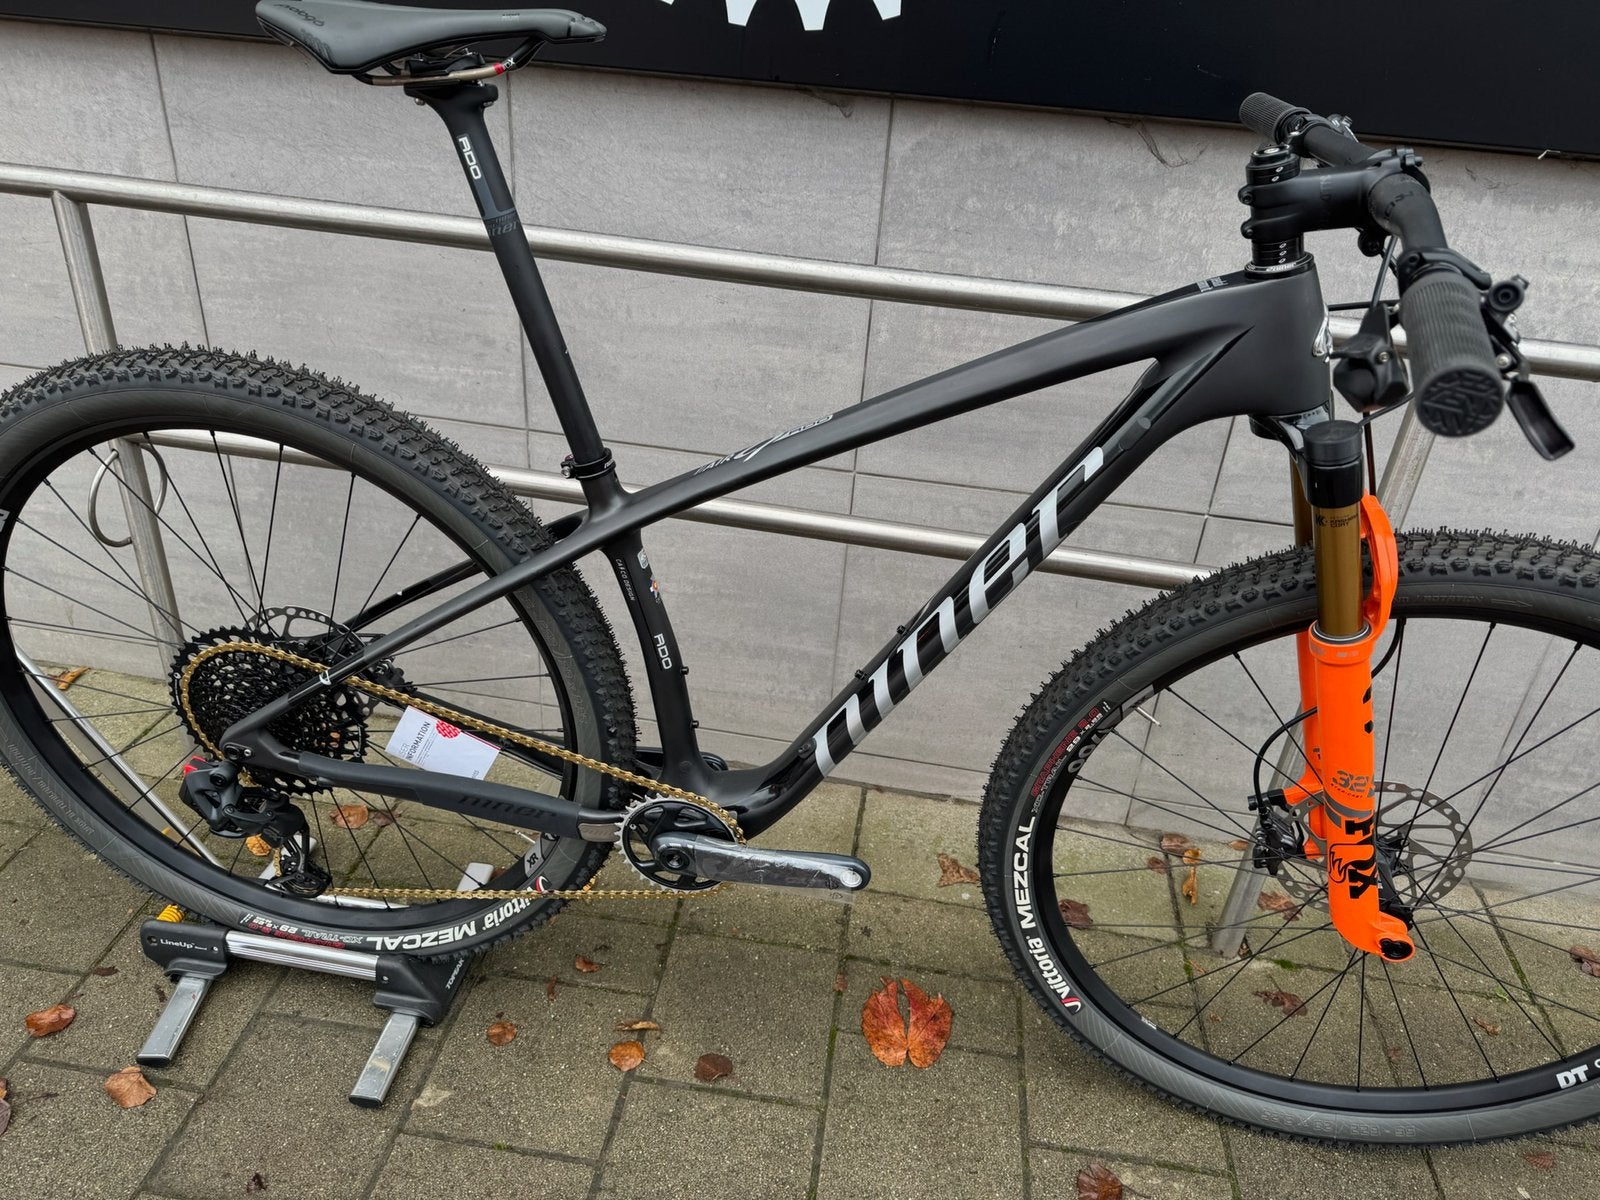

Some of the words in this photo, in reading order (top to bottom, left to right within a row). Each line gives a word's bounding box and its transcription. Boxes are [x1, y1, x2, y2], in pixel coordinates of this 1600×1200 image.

[458, 136, 481, 179] RDO
[813, 446, 1104, 778] niner
[654, 633, 672, 670] RDO
[1332, 770, 1369, 792] 32
[458, 795, 557, 818] niner
[526, 852, 539, 868] XR
[1013, 816, 1037, 929] MEZCAL
[160, 938, 194, 949] LineUp
[366, 920, 477, 950] MEZCAL
[1556, 1064, 1589, 1089] DT
